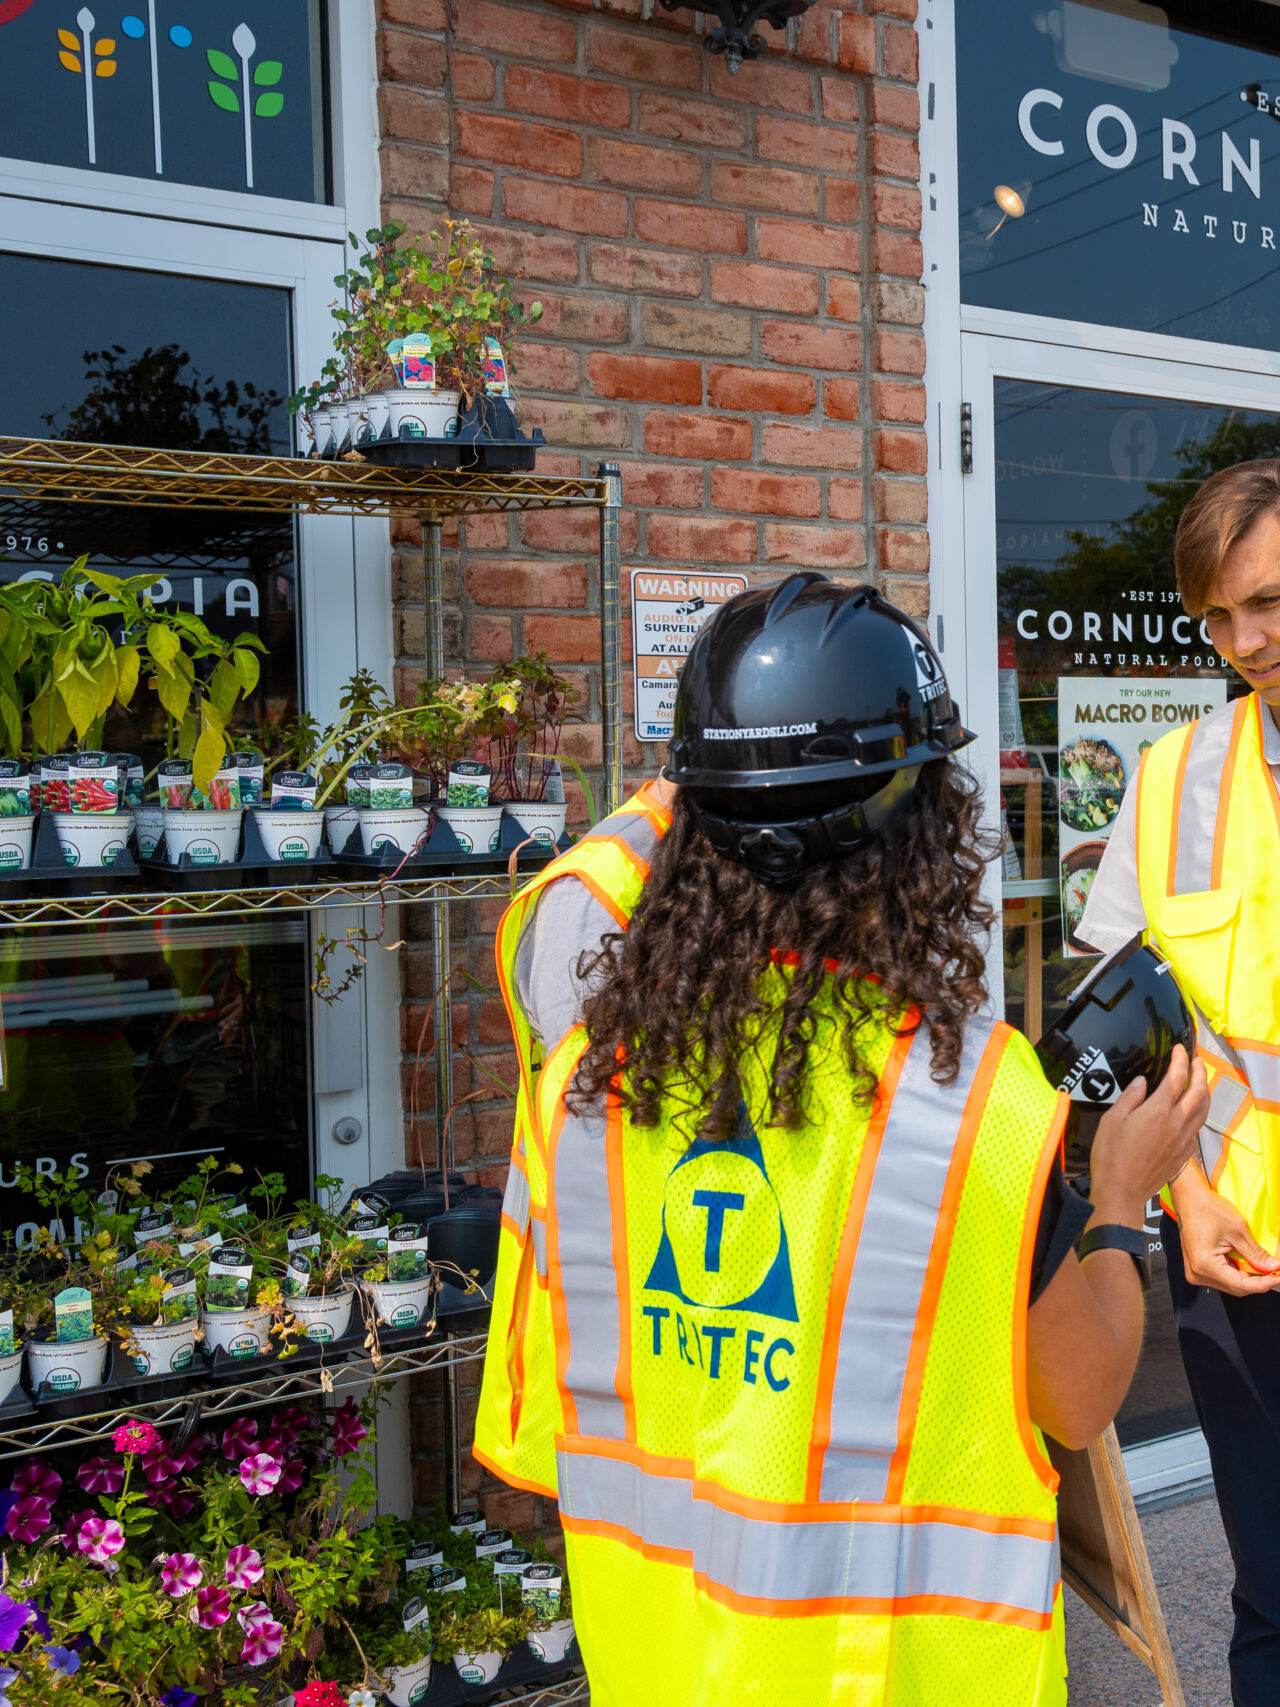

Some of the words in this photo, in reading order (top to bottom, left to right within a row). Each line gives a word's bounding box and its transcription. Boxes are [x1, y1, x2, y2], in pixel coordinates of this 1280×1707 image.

[638, 578, 741, 598] WARNING
[1130, 591, 1154, 601] EST
[643, 614, 684, 623] AUDIO
[687, 614, 697, 624] &
[665, 634, 682, 643] ON
[651, 644, 668, 653] AT
[1075, 654, 1168, 666] NATURAL
[1120, 689, 1134, 697] TRY
[1154, 689, 1172, 697] NEW
[1075, 704, 1146, 723] MACRO
[192, 847, 213, 855] USDA
[1057, 1045, 1101, 1093] TRITEC
[692, 1189, 745, 1273] T
[397, 1310, 414, 1318] USDA
[642, 1306, 796, 1393] TRITEC
[52, 1374, 73, 1382] USDA
[462, 1669, 479, 1677] USDA
